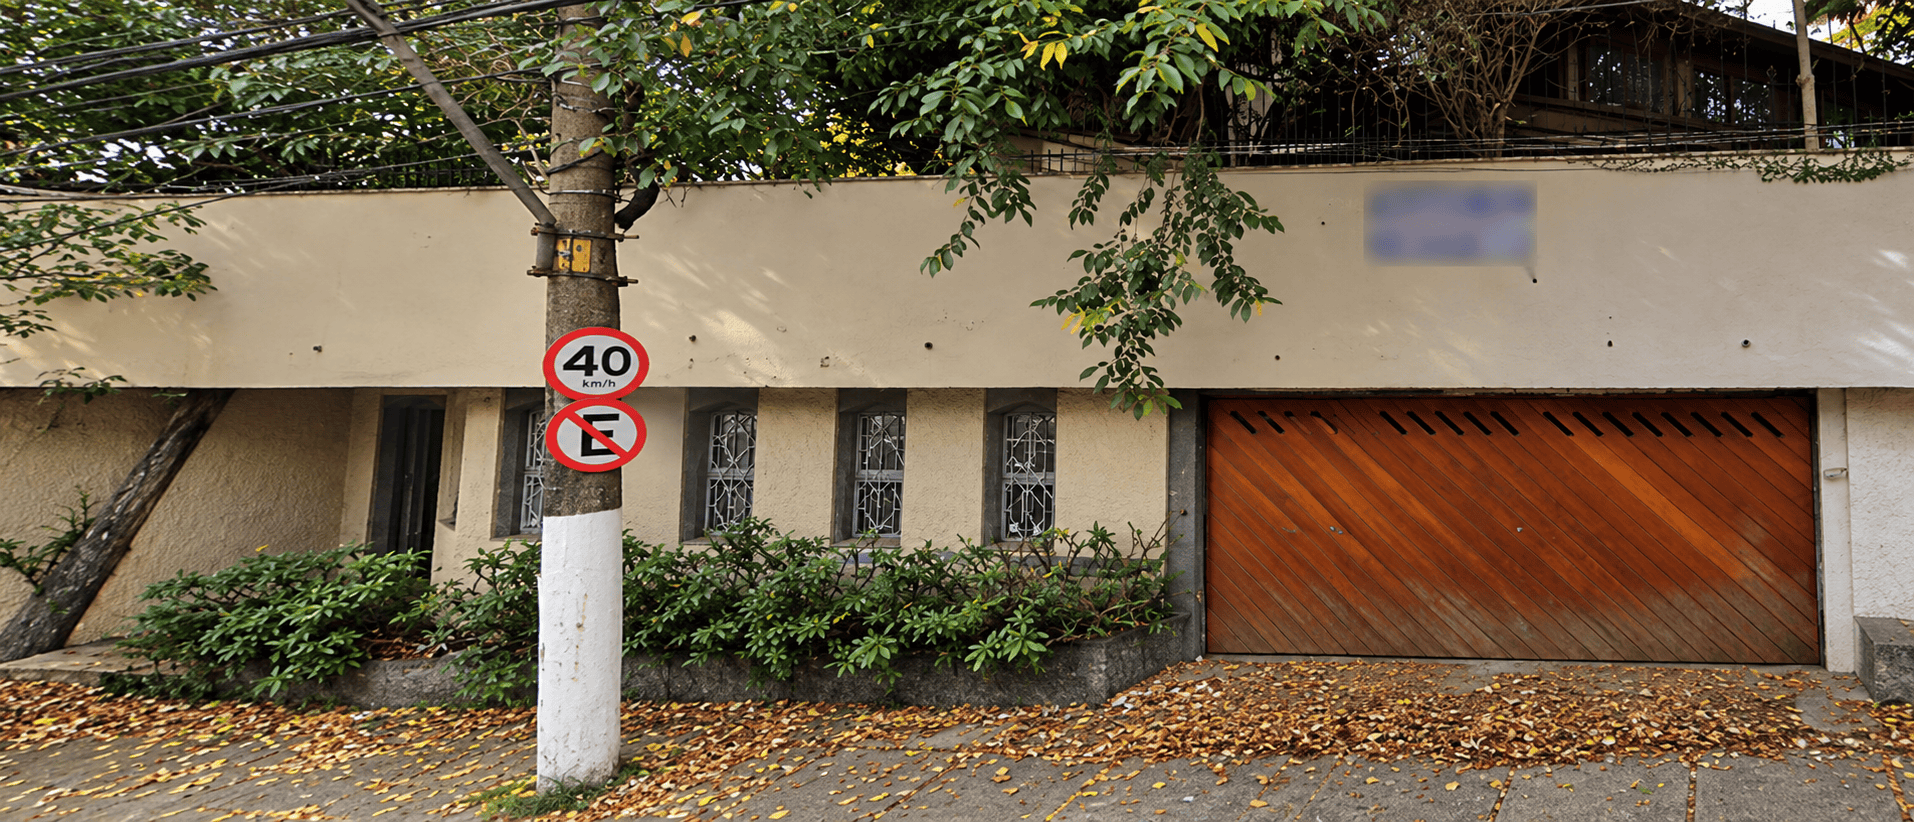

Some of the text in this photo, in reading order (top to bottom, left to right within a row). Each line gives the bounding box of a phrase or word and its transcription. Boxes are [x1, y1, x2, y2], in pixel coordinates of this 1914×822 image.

[562, 345, 632, 377] 40
[582, 379, 616, 388] km/h
[580, 413, 621, 457] E
